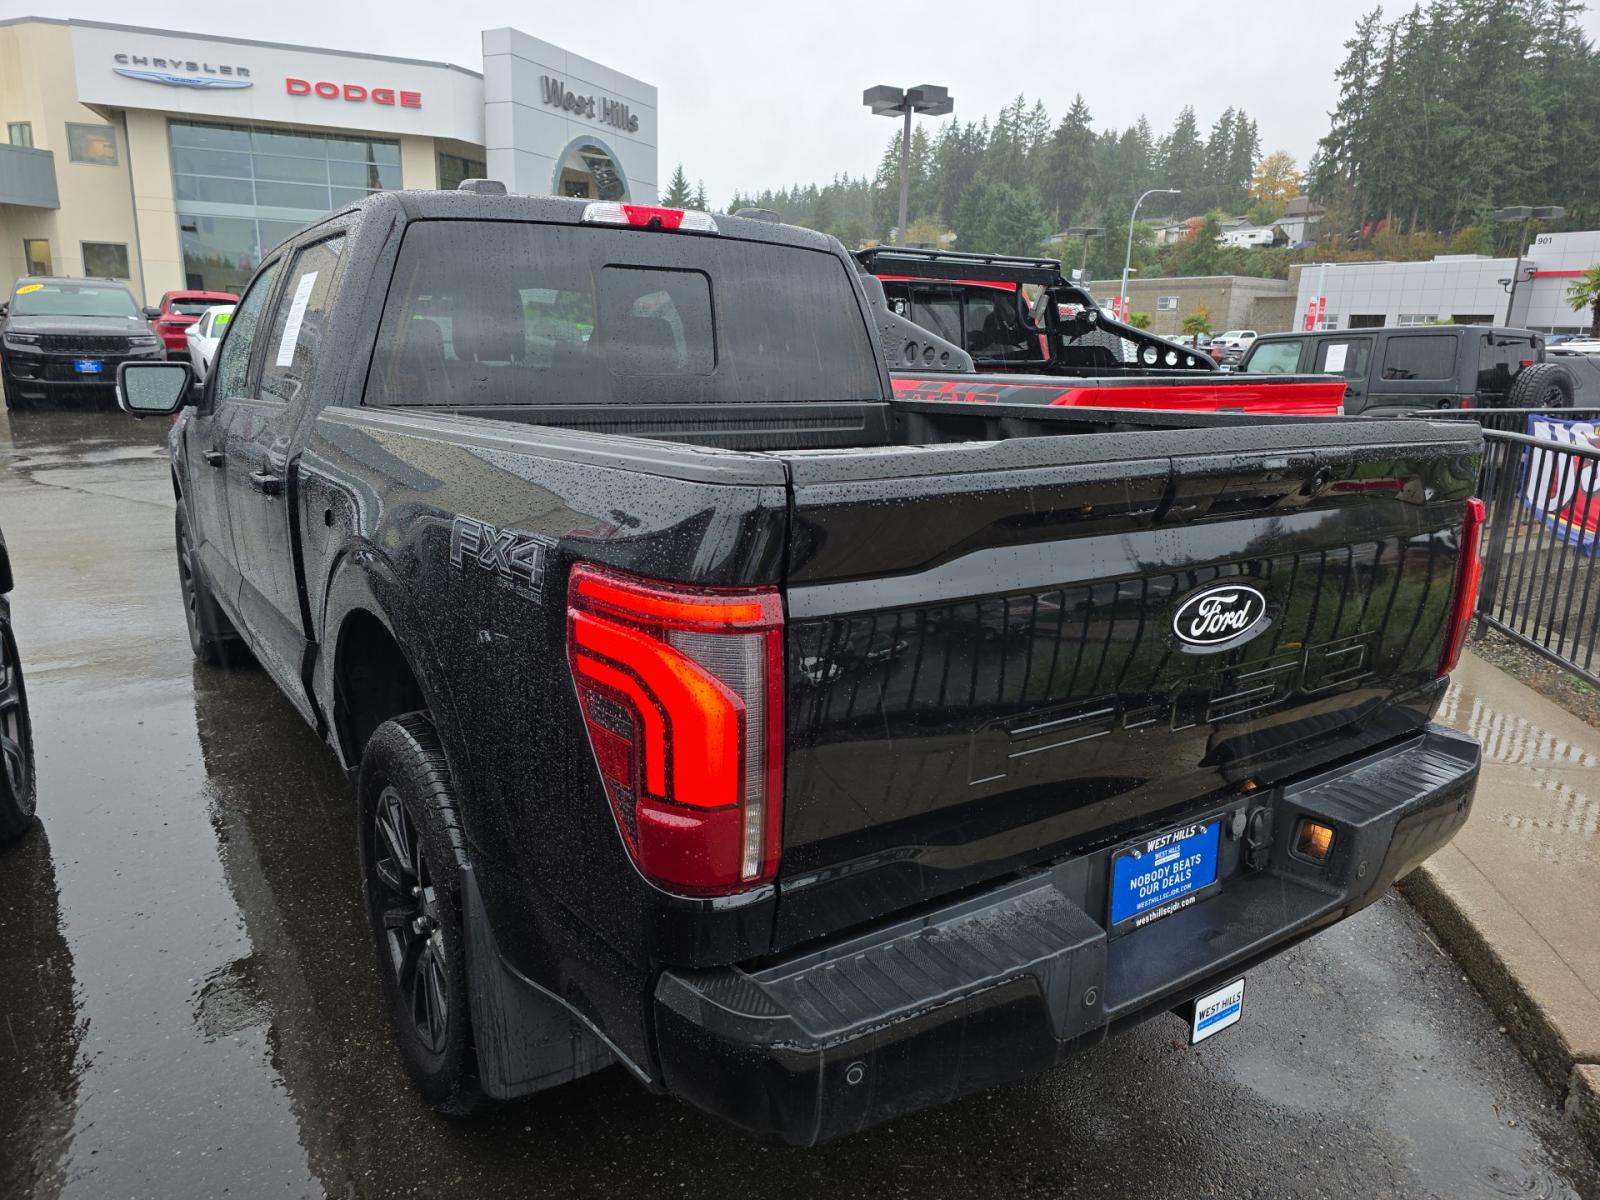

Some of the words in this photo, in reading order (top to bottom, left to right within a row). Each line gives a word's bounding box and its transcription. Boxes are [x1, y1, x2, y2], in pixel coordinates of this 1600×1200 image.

[113, 53, 251, 78] CHRYSLER
[285, 78, 422, 109] DODGE
[541, 75, 596, 119] West
[599, 96, 640, 133] Hills
[1537, 237, 1553, 245] 901
[449, 514, 547, 593] FX4
[1190, 593, 1252, 637] Ford
[1147, 836, 1173, 853] WEST
[1173, 825, 1197, 843] HILLS
[1130, 865, 1171, 891] NOBODY
[1173, 853, 1202, 873] BEATS
[1139, 882, 1160, 898] OUR
[1162, 868, 1192, 890] DEALS
[1135, 896, 1196, 927] westhillscjdr.com
[1199, 1001, 1221, 1021] WEST
[1221, 991, 1242, 1009] HILLS
